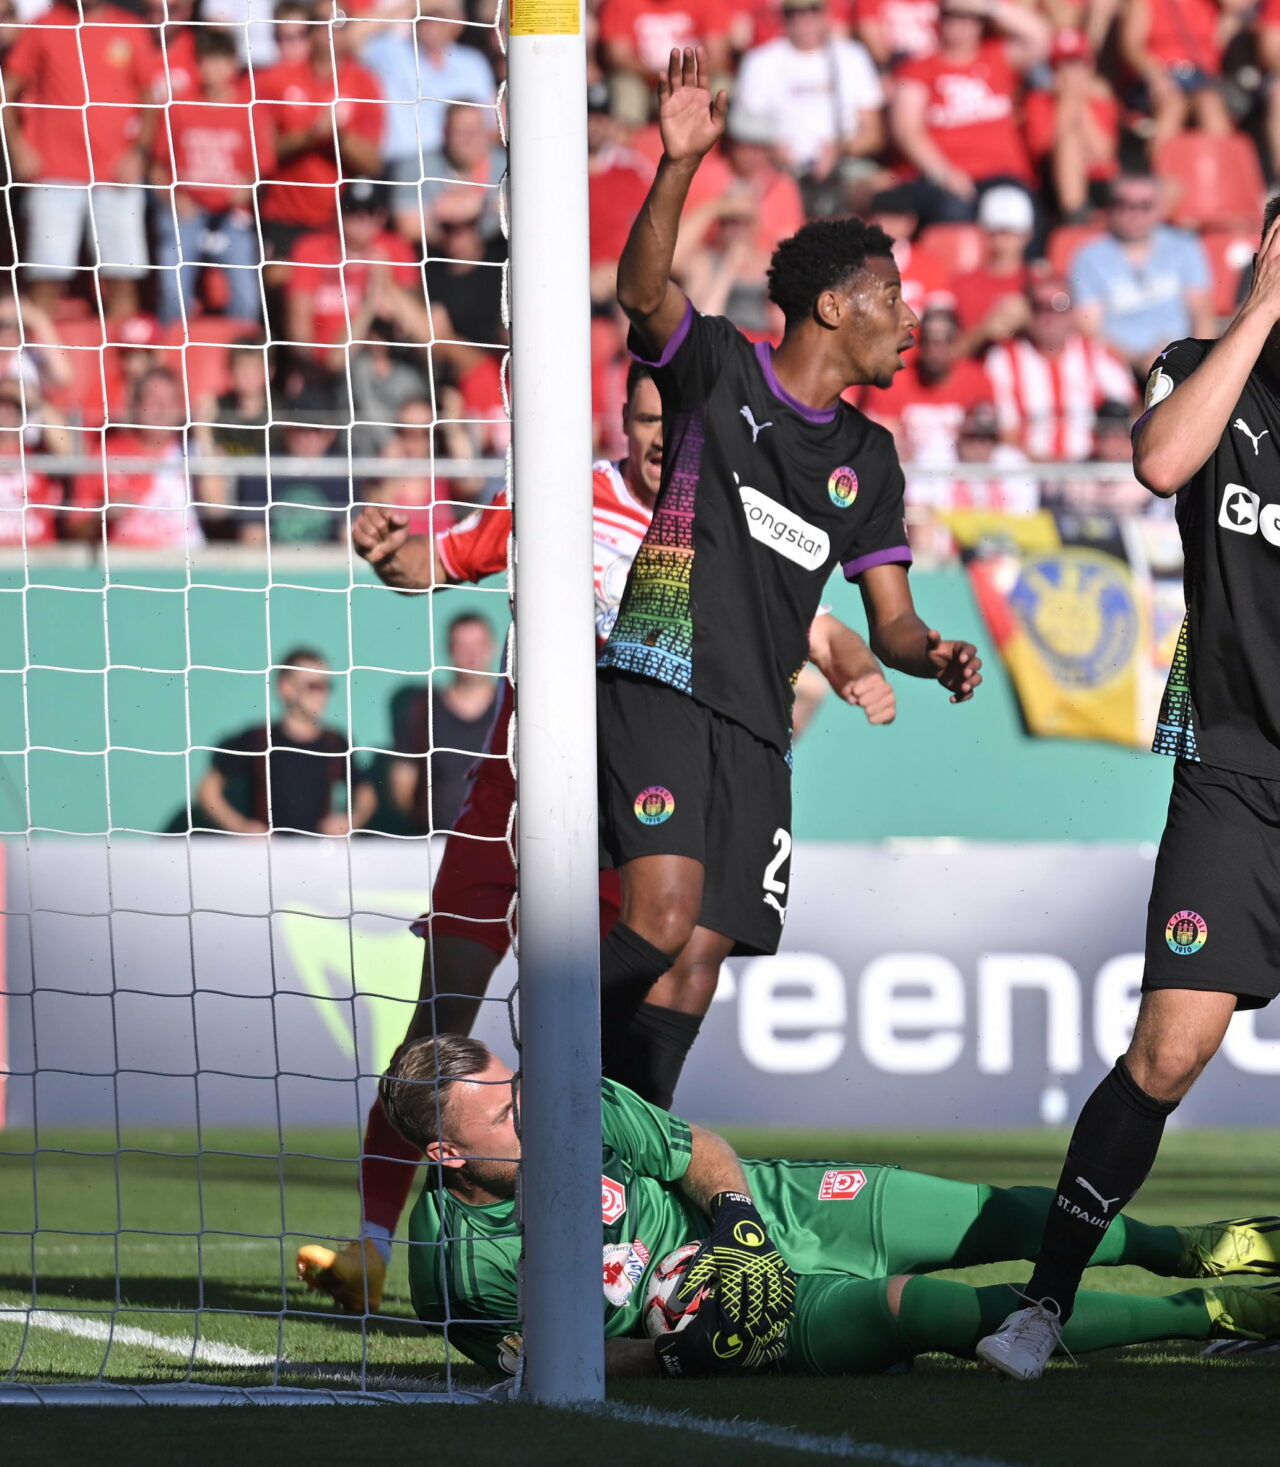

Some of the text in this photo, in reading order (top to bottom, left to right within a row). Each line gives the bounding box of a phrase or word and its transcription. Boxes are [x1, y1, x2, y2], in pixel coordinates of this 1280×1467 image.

[1187, 911, 1206, 933] PAULI
[1175, 945, 1192, 953] 1910
[822, 1172, 836, 1196] HFC
[1057, 1194, 1110, 1230] ST.PAULI
